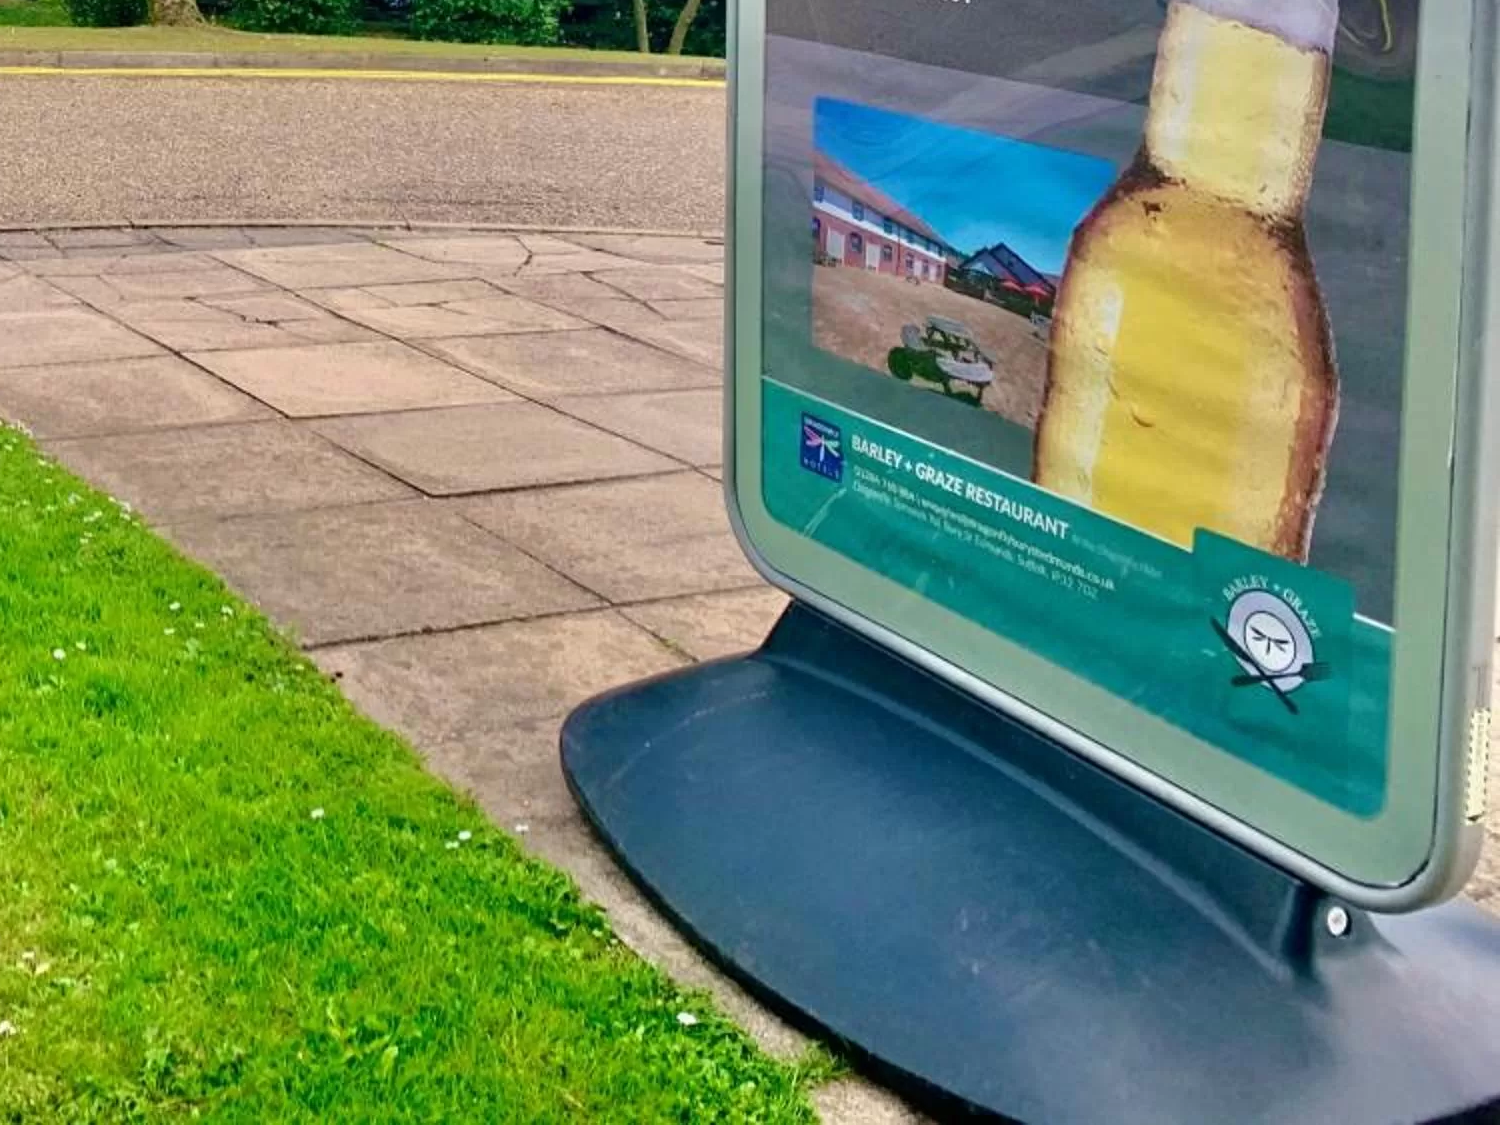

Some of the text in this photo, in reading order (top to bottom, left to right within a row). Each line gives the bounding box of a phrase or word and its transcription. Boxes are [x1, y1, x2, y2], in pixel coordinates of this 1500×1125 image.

[851, 434, 903, 470] BARLEY
[915, 462, 963, 497] GRAZE
[965, 482, 1070, 540] RESTAURANT
[1222, 574, 1269, 602] BARLEY
[1283, 586, 1322, 639] GRAZE
